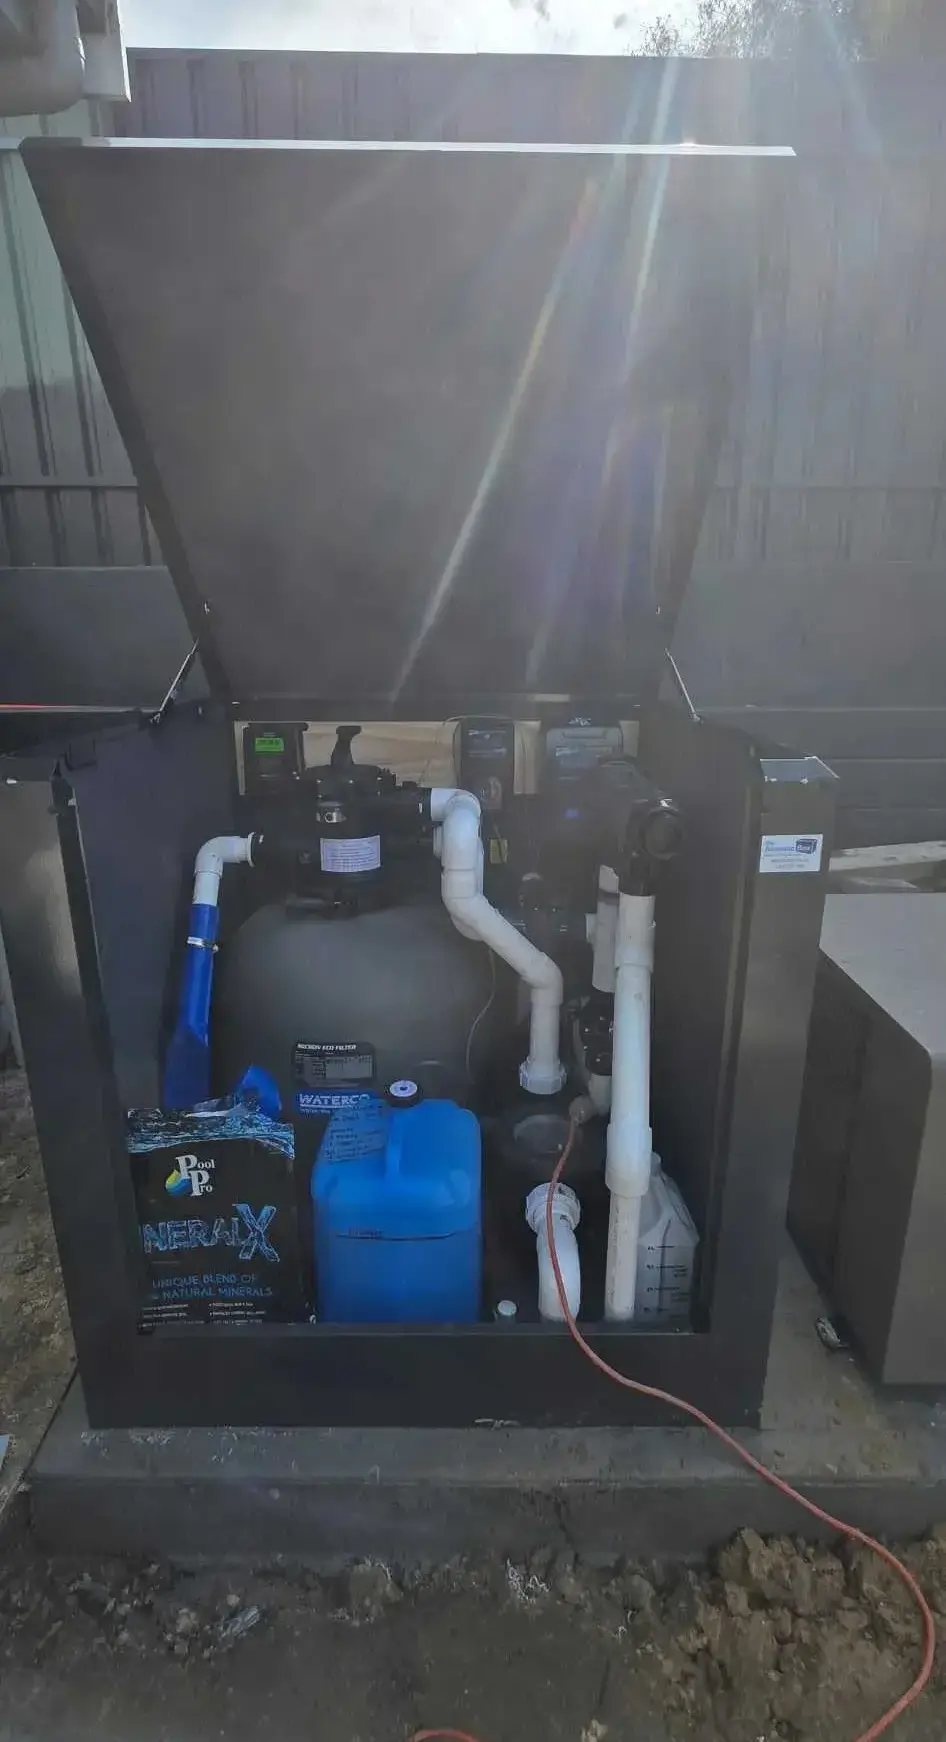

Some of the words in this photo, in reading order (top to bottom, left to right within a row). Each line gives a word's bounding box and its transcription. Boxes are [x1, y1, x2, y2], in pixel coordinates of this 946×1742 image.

[175, 1154, 216, 1179] Pool
[190, 1170, 213, 1196] Pro
[139, 1203, 280, 1263] NERALX
[152, 1275, 199, 1290] UNIQUE
[203, 1273, 237, 1286] BLEND
[241, 1273, 257, 1285] OF
[163, 1287, 216, 1301] NATURAL
[218, 1285, 273, 1298] MINERALS
